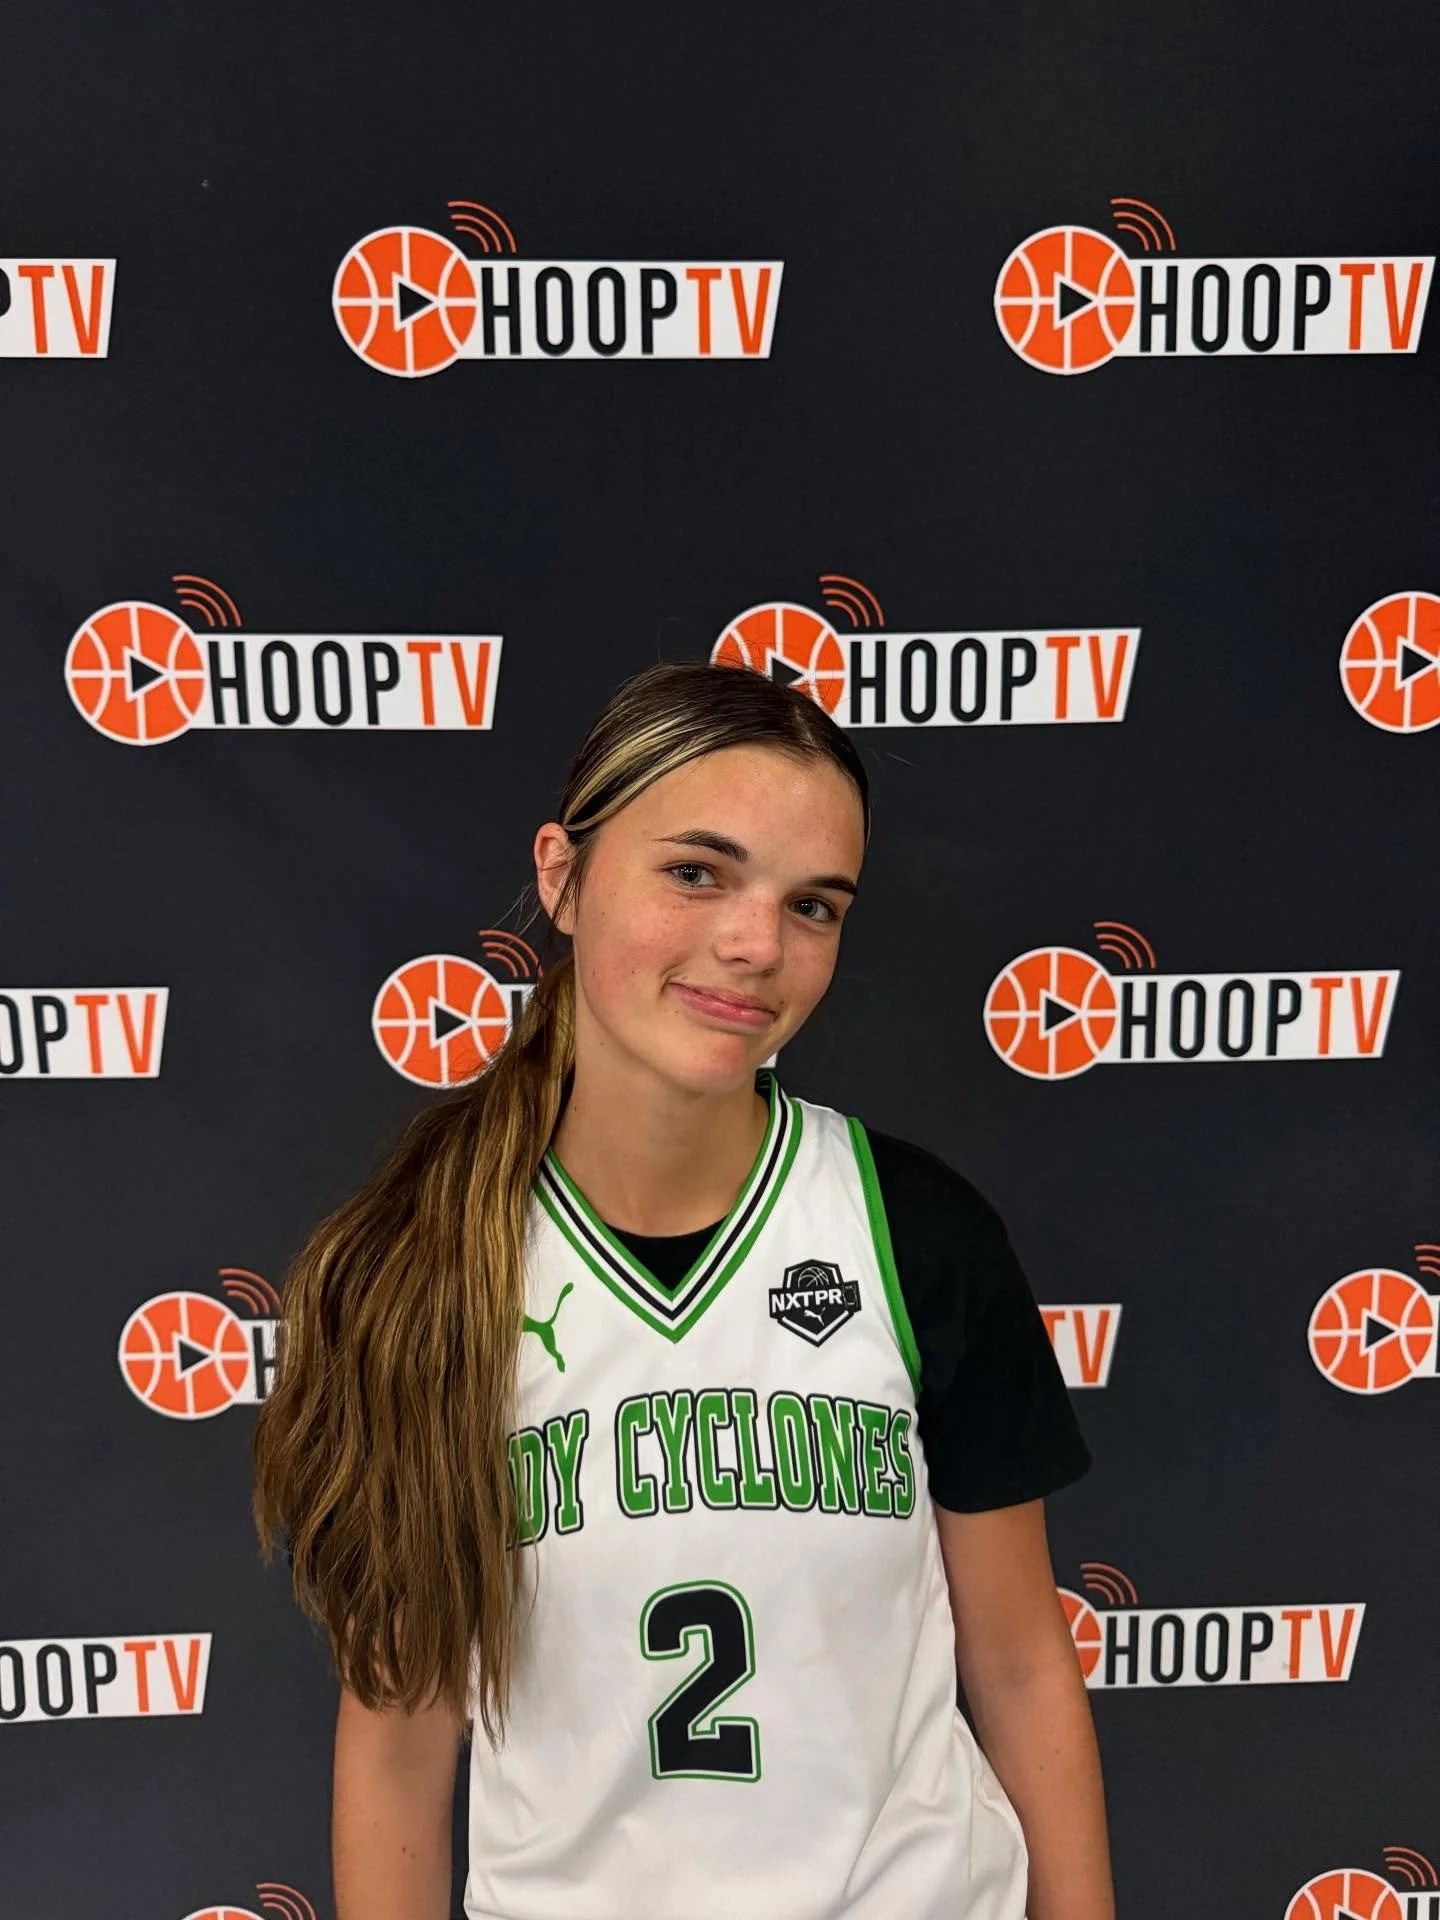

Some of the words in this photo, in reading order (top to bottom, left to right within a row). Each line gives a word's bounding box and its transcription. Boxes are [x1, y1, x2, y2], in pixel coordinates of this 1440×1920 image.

[481, 266, 771, 356] HOOPTV
[1138, 263, 1423, 353] HOOPTV
[207, 640, 491, 725] HOOPTV
[848, 635, 1129, 723] HOOPTV
[1119, 976, 1388, 1060] HOOPTV
[615, 1388, 917, 1519] CYCLONES
[0, 1640, 201, 1721] OOPTV
[639, 1579, 762, 1783] 2
[1103, 1609, 1354, 1685] HOOPTV
